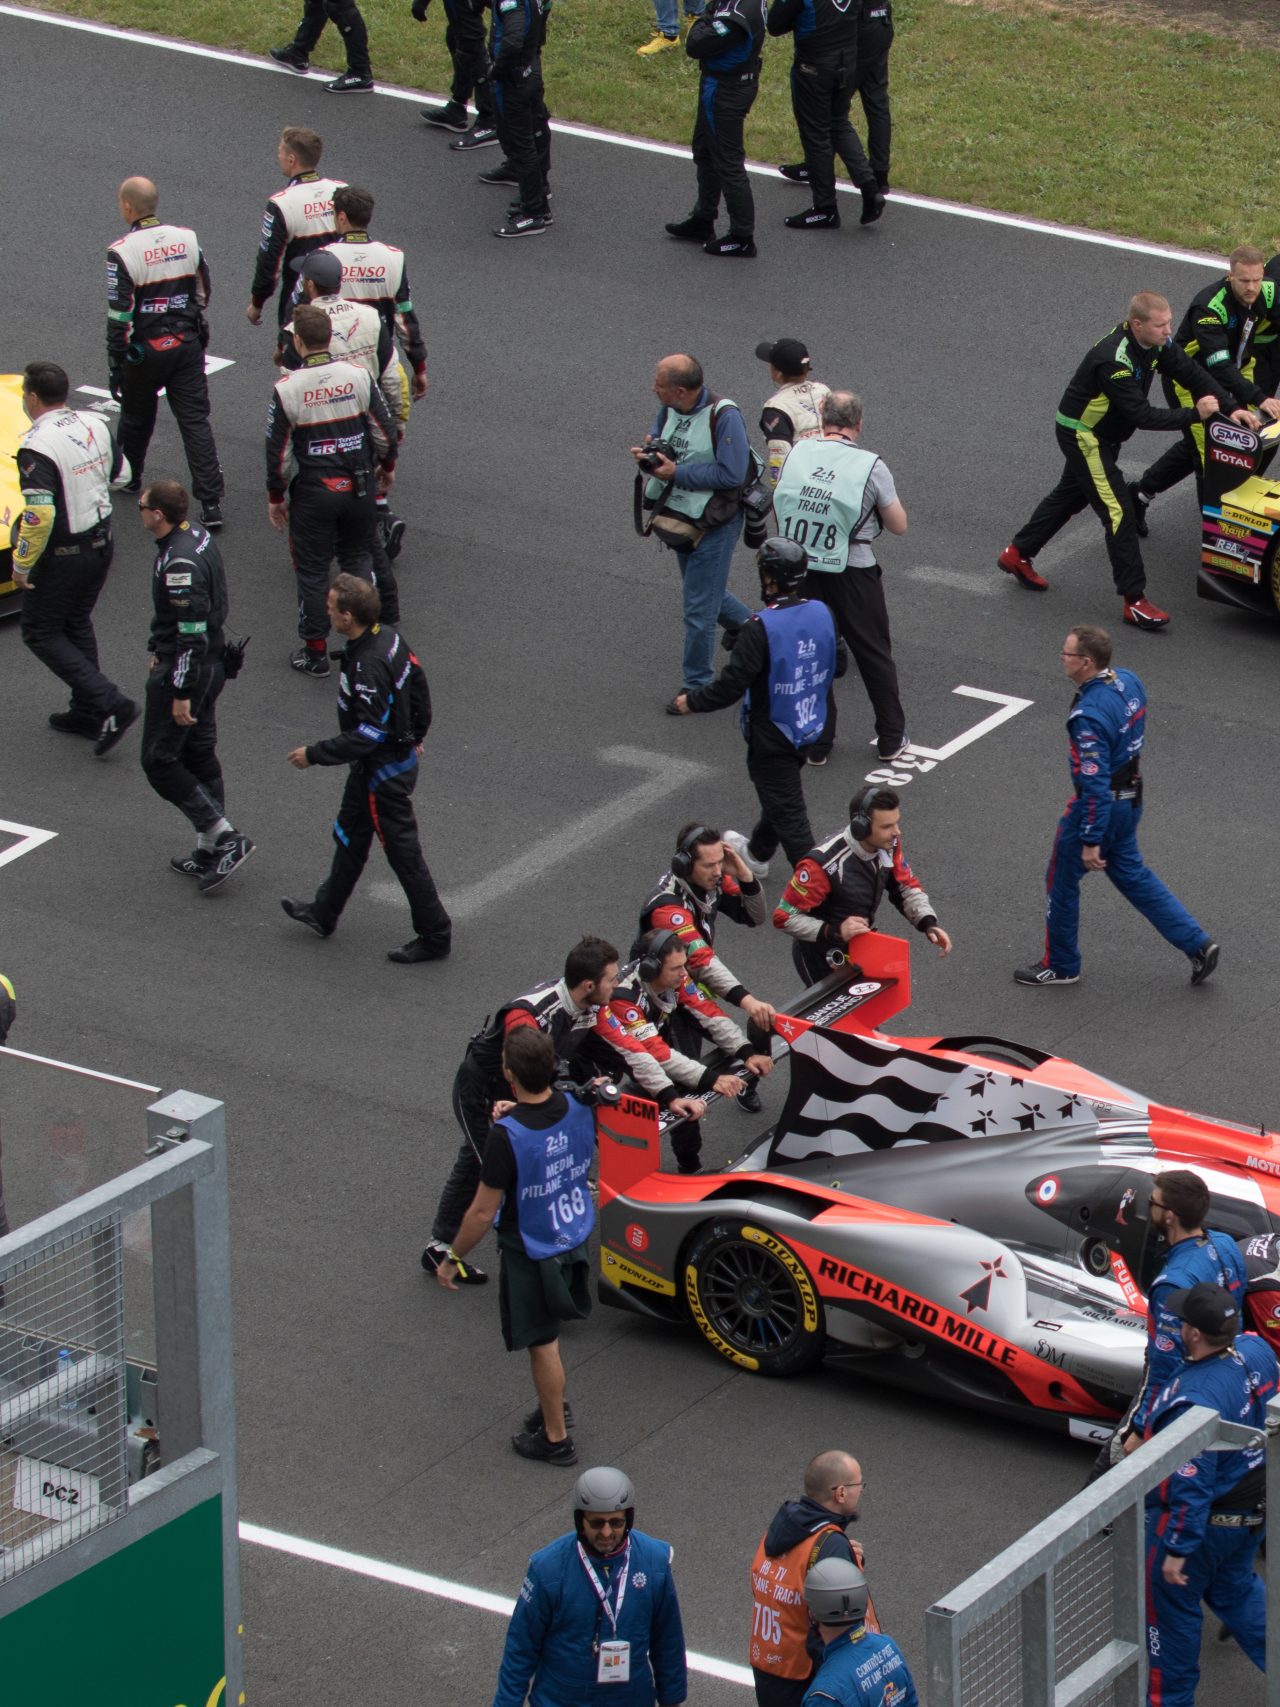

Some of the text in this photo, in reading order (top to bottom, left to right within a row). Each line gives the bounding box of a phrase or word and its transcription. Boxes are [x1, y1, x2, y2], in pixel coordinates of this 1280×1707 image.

[304, 201, 335, 215] DENS
[144, 243, 186, 262] DENSO
[341, 266, 385, 277] DENSO
[304, 383, 354, 403] DENSO
[672, 437, 689, 450] EDIA
[1216, 427, 1251, 446] SAMS
[1213, 449, 1253, 468] TOTAL
[800, 485, 833, 502] MEDIA
[797, 498, 831, 515] TRACK
[1232, 512, 1270, 528] DUNLOP
[785, 516, 837, 551] 1078
[806, 994, 852, 1022] BANQUE
[546, 1153, 574, 1179] MEDIA
[521, 1176, 562, 1200] PITLANE
[548, 1186, 586, 1231] 168
[619, 1262, 664, 1289] DUNLOP
[763, 1237, 817, 1324] DUNLOP
[1112, 1259, 1140, 1306] FUEL
[688, 1273, 740, 1359] DUNLOP
[818, 1256, 1018, 1369] RICHARD MILLE
[1082, 1310, 1138, 1329] RICHARD
[43, 1481, 80, 1505] DC2
[760, 1559, 788, 1581] HB TV
[753, 1574, 802, 1606] LANE TRACK
[753, 1601, 783, 1646] 705
[1151, 1625, 1160, 1657] FORD
[861, 1677, 872, 1693] PIT
[882, 1654, 904, 1676] CONTROL
